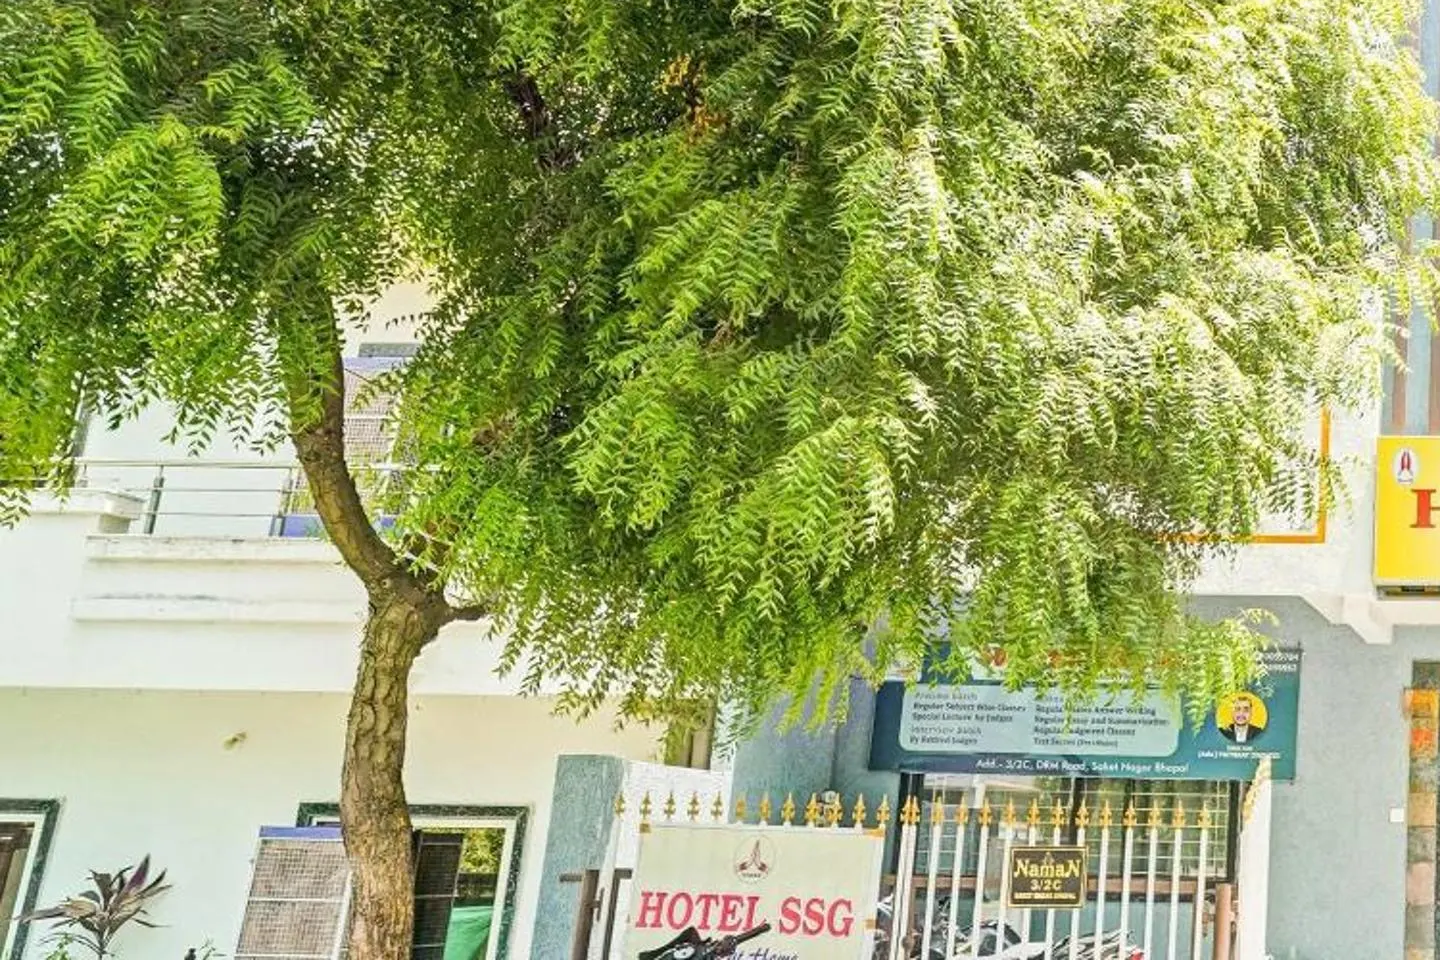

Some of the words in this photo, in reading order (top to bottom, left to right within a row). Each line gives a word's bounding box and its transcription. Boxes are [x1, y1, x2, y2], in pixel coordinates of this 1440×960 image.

[1091, 761, 1118, 772] Saket
[1120, 761, 1151, 774] Nagar
[1154, 761, 1189, 774] Bhopal
[1013, 857, 1081, 878] NamaN
[635, 891, 767, 932] HOTEL
[778, 896, 855, 937] SSG
